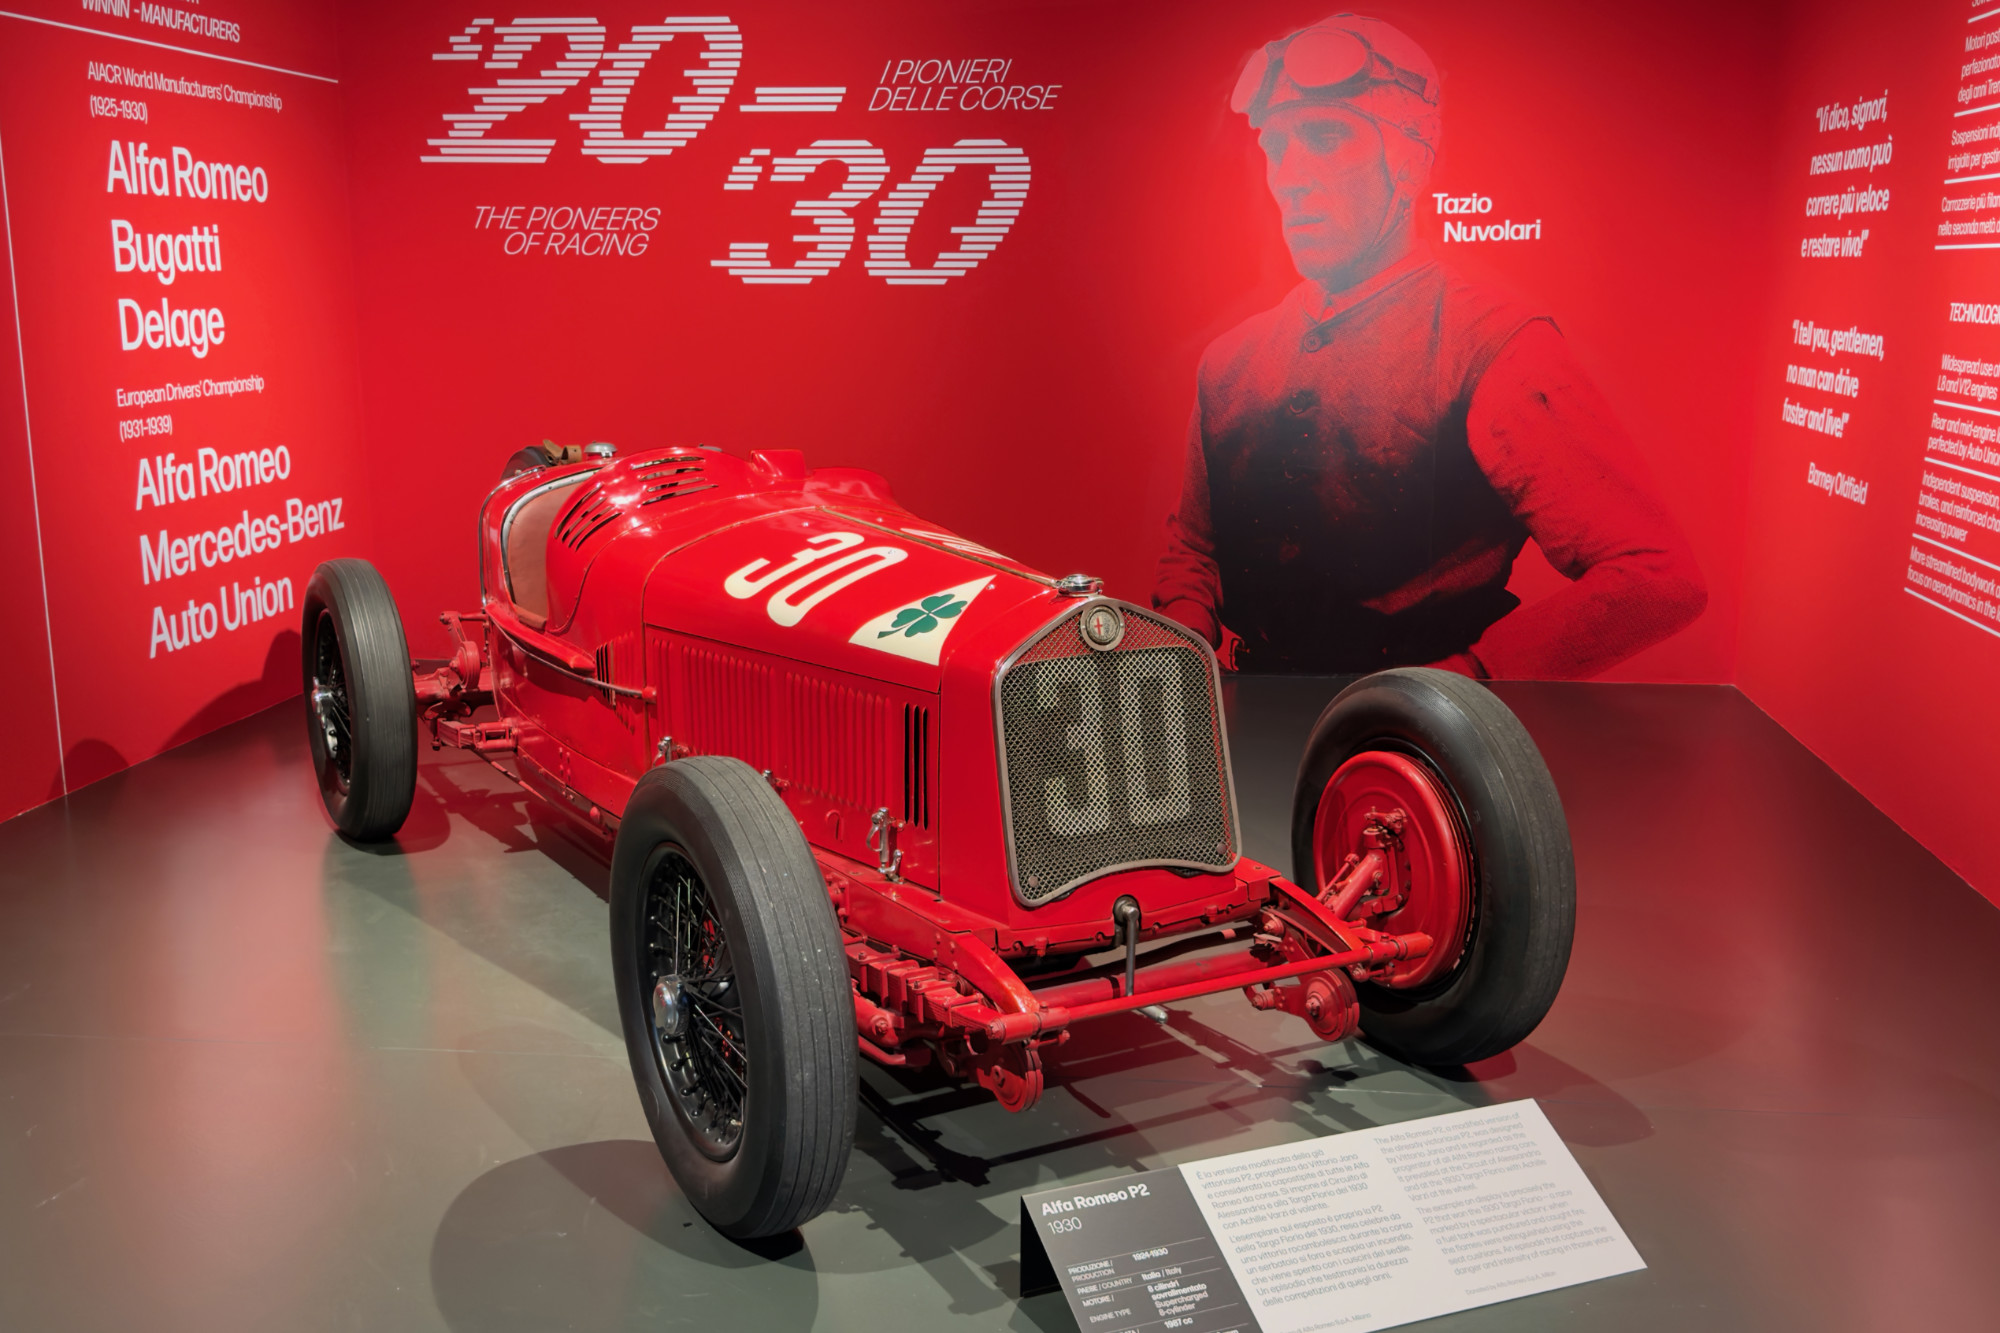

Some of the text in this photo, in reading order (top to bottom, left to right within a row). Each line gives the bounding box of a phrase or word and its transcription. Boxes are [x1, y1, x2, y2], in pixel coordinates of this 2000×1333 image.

[141, 2, 241, 43] MANUFACTURERS
[881, 58, 1013, 84] I PIONIERI
[88, 61, 283, 113] AIACR World Manufacturers' Championship
[868, 85, 1063, 112] DELLE CORSE
[1958, 84, 1974, 104] degli
[1973, 81, 1987, 100] anni
[90, 95, 149, 124] (1925-1930)
[1851, 89, 1888, 131] signori,
[1951, 124, 1989, 147] Sospensioni
[1810, 134, 1893, 176] nessun uomo può
[1970, 152, 1983, 170] per
[107, 140, 269, 203] Alfa Romeo
[1432, 193, 1493, 215] Tazio
[1806, 183, 1890, 220] correre più veloce
[1941, 194, 1976, 213] Carrozzerie
[474, 206, 662, 231] THE PIONEERS
[1443, 219, 1541, 243] Nuvolari
[1937, 220, 1952, 237] nella
[1952, 219, 1979, 236] seconda
[111, 219, 223, 286] Bugatti
[504, 232, 651, 257] OF RACING
[1801, 238, 1808, 258] e
[1807, 233, 1840, 258] restare
[118, 297, 225, 358] Delage
[1798, 321, 1814, 346] tell
[1830, 325, 1884, 362] gentlemen,
[1941, 353, 1981, 376] Widespread
[1980, 362, 1994, 377] use
[116, 374, 265, 408] European Drivers' Championship
[1786, 364, 1859, 398] no man can drive
[1945, 377, 1960, 394] and
[1970, 381, 1998, 402] engines
[1782, 397, 1808, 427] faster
[1807, 407, 1826, 432] and
[1931, 412, 1947, 431] Rear
[1946, 418, 1961, 434] and
[119, 414, 173, 443] (1931-1939)
[1927, 435, 1960, 456] perfected
[1966, 442, 1983, 461] Auto
[136, 445, 291, 511] Alfa Romeo
[1807, 462, 1869, 505] Barney Oldfield
[1922, 469, 1961, 497] Independent
[1915, 508, 1969, 542] increasing power
[1940, 500, 1954, 516] and
[1953, 503, 1988, 527] reinforced
[140, 497, 345, 585] Mercedes-Benz
[724, 531, 909, 628] 30
[1909, 545, 1926, 566] More
[1961, 566, 1996, 597] bodywork
[1907, 564, 1924, 586] focus
[1932, 580, 1977, 610] aerodynamics
[1983, 600, 1997, 620] the
[150, 575, 294, 660] Auto Union
[1034, 651, 1192, 836] 30
[1201, 1177, 1241, 1190] vittoriosa
[1254, 1165, 1298, 1180] progettata
[1307, 1158, 1338, 1168] Vittorio
[1212, 1165, 1248, 1177] versione
[1248, 1156, 1292, 1170] modificata
[1042, 1183, 1150, 1216] Alfa Romeo P2
[1047, 1217, 1082, 1234] 1930
[1068, 1260, 1110, 1275] PRODUZIONE
[1071, 1268, 1115, 1282] PRODUCTION
[1141, 1271, 1161, 1280] Italia
[1165, 1267, 1182, 1276] Italy
[1101, 1277, 1132, 1289] COUNTRY
[1150, 1283, 1207, 1300] sovralimentato
[1154, 1280, 1180, 1291] cilindri
[1082, 1295, 1111, 1307] MOTORE
[1154, 1290, 1209, 1308] Supercharged
[1089, 1308, 1131, 1323] ENGINE TYPE
[1164, 1318, 1182, 1328] 1987
